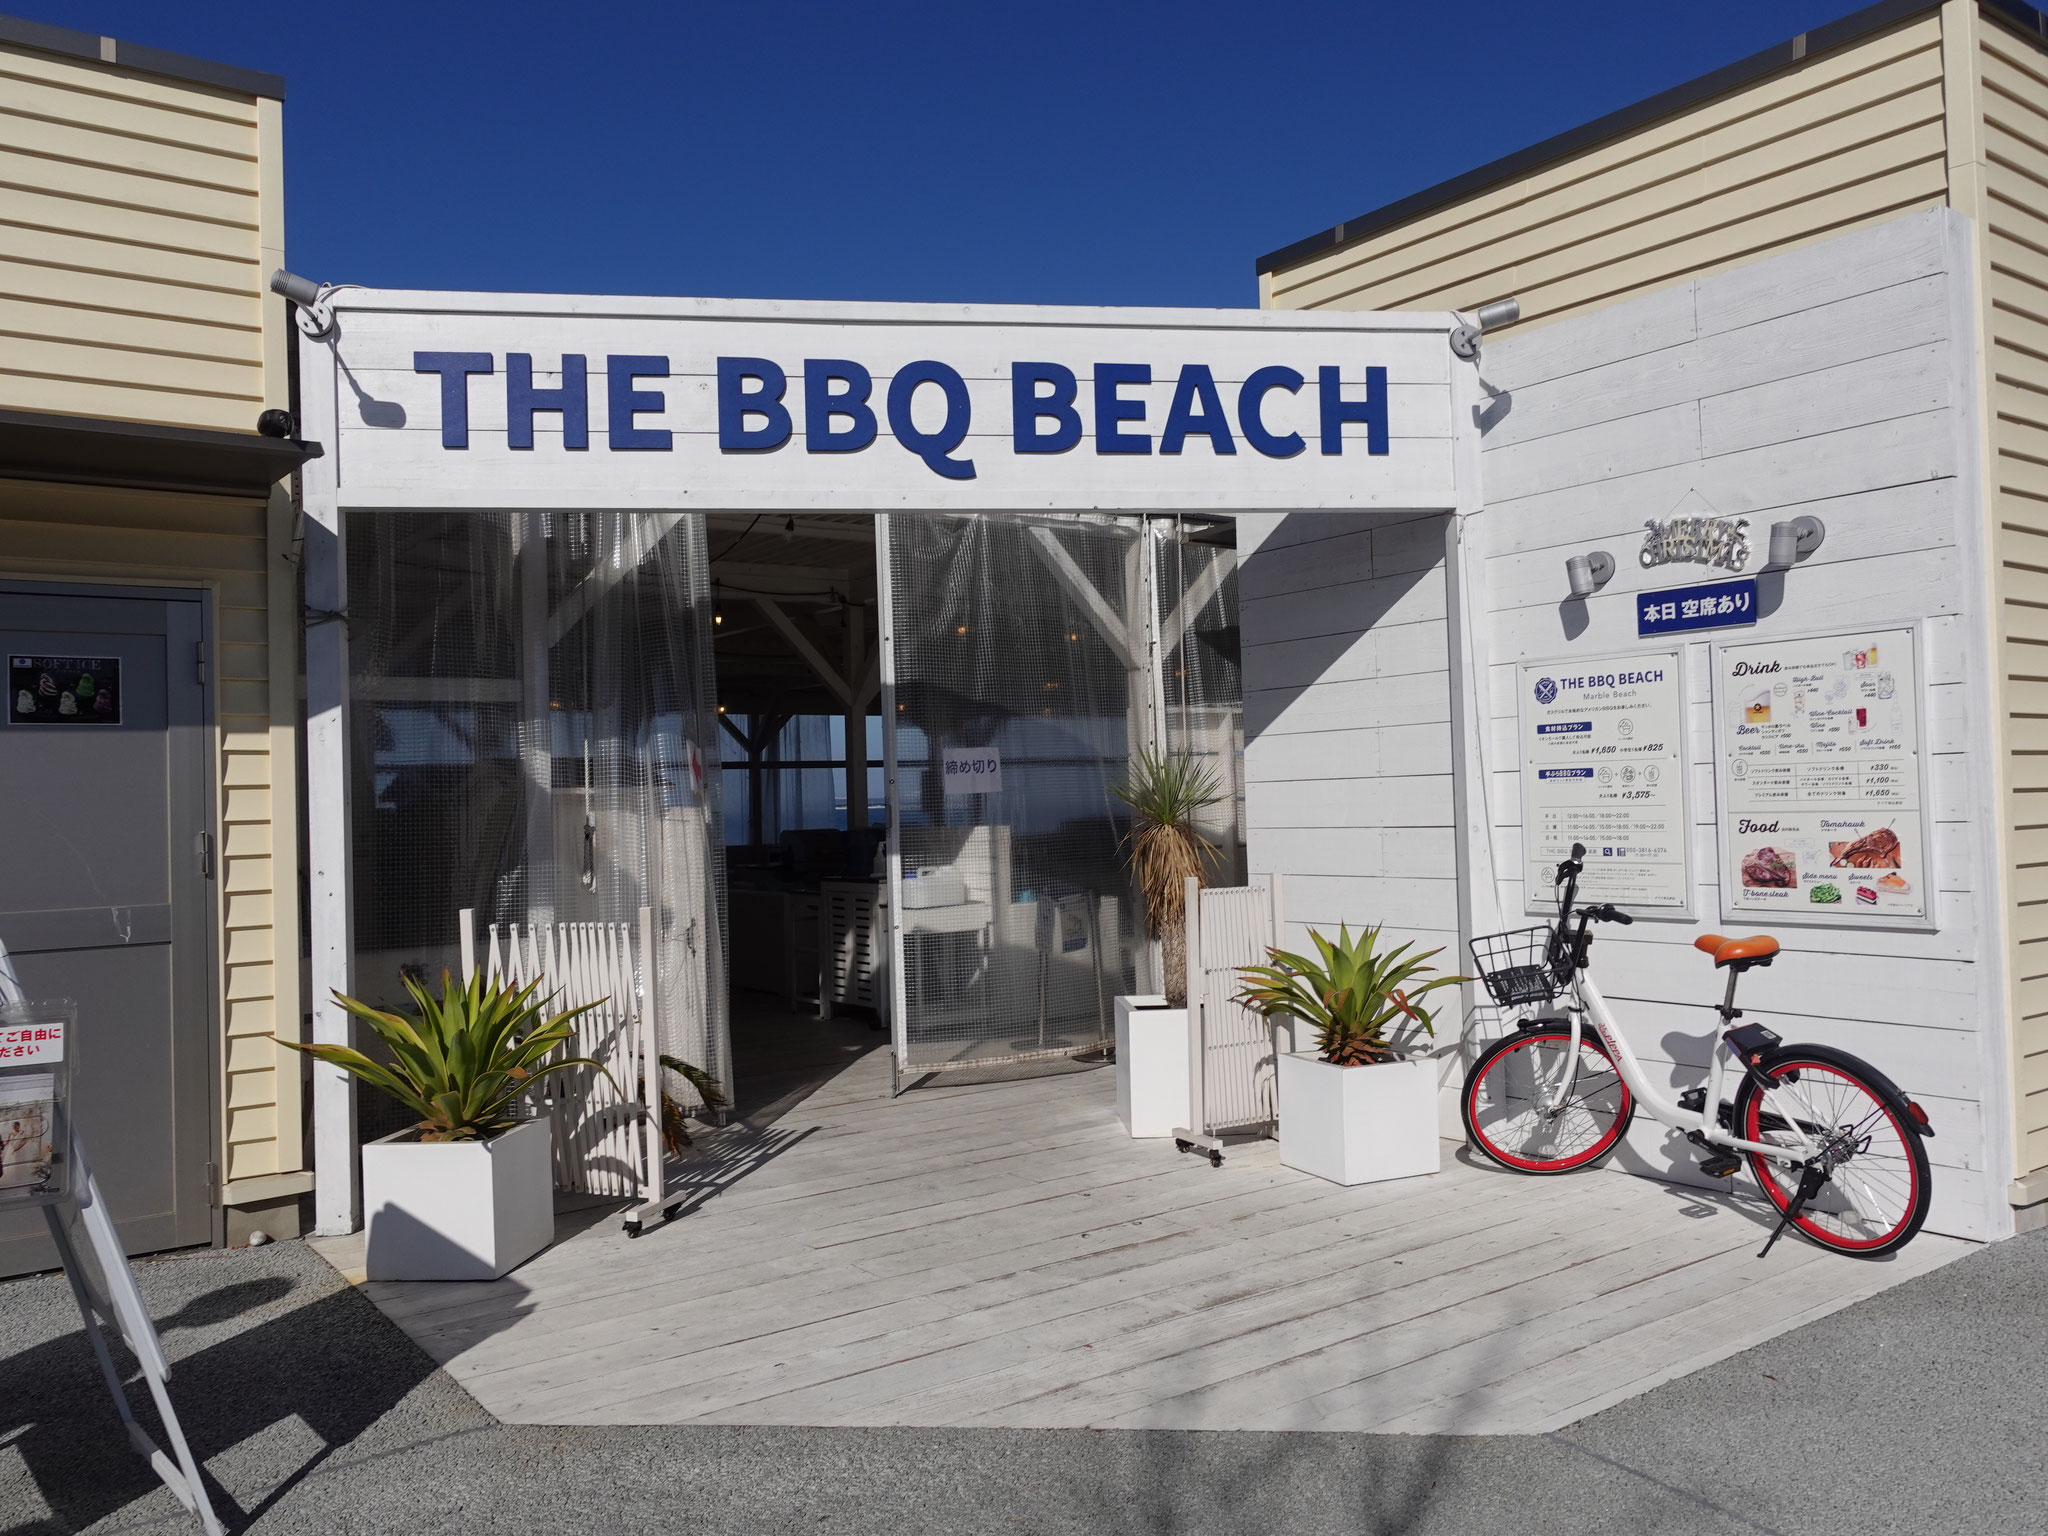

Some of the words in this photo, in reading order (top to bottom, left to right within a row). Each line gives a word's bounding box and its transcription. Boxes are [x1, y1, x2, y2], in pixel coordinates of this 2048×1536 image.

[414, 351, 673, 452] THE
[717, 356, 976, 479] BBQ
[1012, 361, 1390, 457] BEACH
[1639, 537, 1752, 572] CHRISTMAS
[1644, 603, 1676, 623] 本日
[1681, 592, 1750, 619] 空席あり
[1732, 660, 1782, 677] Drink
[1560, 677, 1585, 690] THE
[1588, 674, 1616, 688] BBQ
[1619, 670, 1664, 685] BEACH
[1583, 691, 1610, 701] Marble
[1613, 689, 1637, 699] Beach
[1736, 724, 1761, 735] Beer
[1591, 746, 1617, 755] ¥1,650
[1643, 743, 1664, 752] ¥825
[945, 759, 997, 776] 締め切り
[1865, 789, 1890, 797] ¥1,650
[1739, 819, 1780, 834] Food
[1820, 819, 1866, 828] Tomahawk
[1802, 872, 1818, 880] Side
[1848, 873, 1874, 881] Sweets
